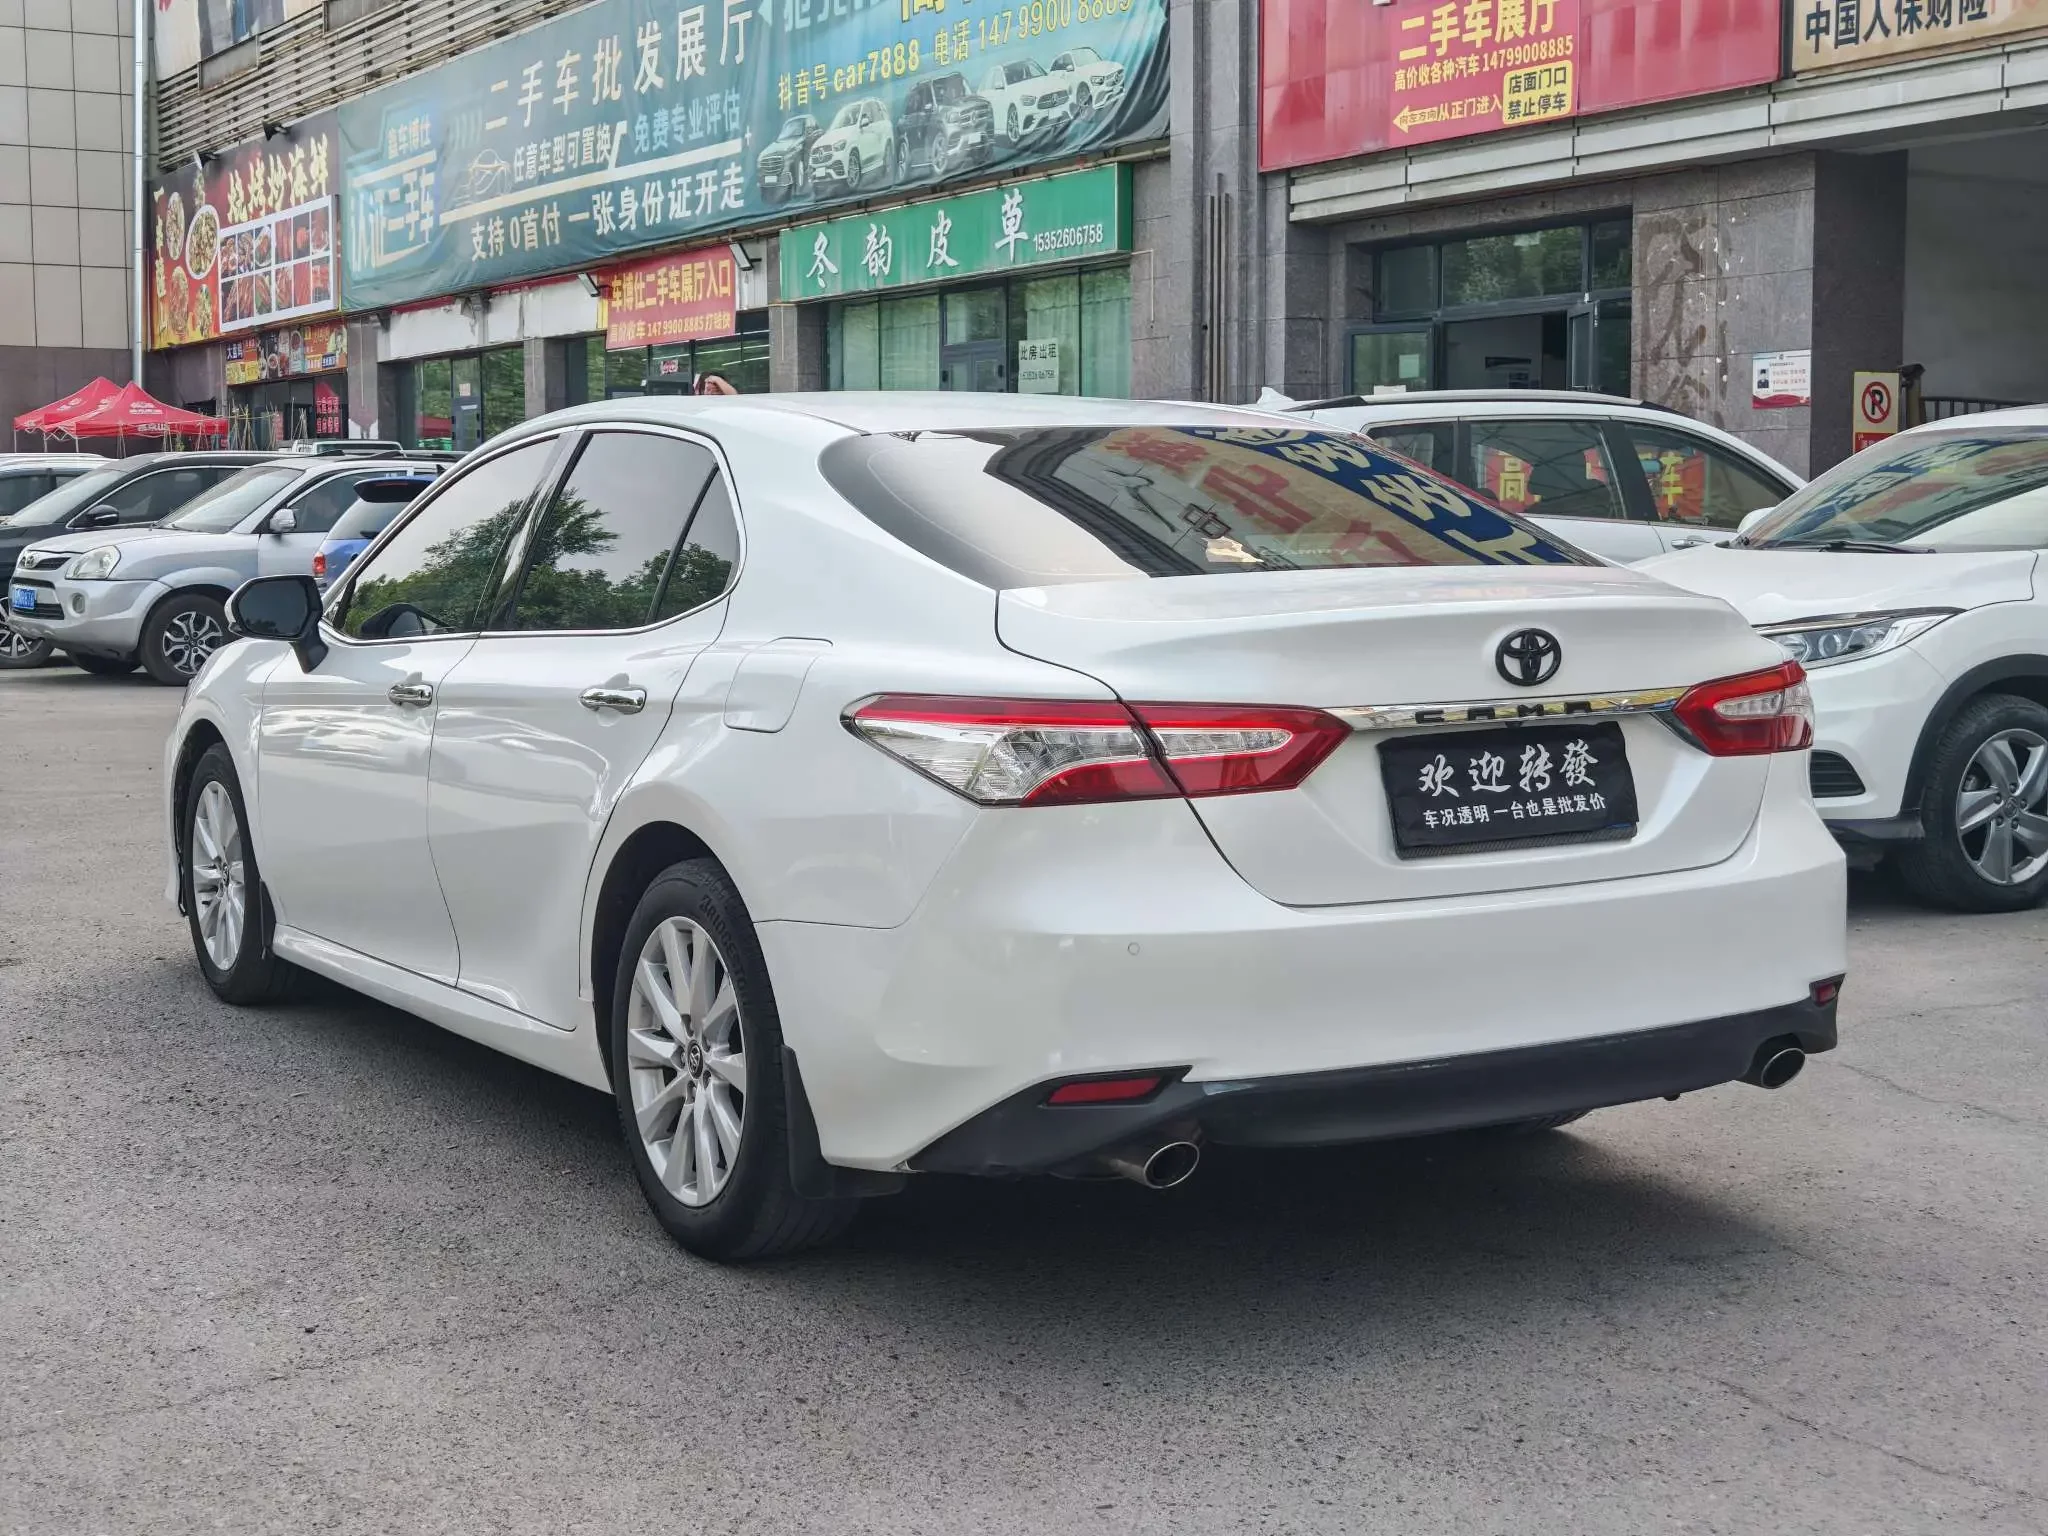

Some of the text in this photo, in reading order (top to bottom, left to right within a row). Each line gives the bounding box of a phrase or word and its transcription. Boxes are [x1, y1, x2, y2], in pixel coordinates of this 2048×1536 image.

[1399, 0, 1560, 60] 二手车展厅
[485, 0, 753, 130] 二手车批发展厅
[778, 63, 827, 110] 抖音号
[834, 39, 919, 92] car7888
[934, 18, 971, 65] 电话
[979, 10, 1012, 51] 147
[1395, 35, 1574, 92] 高价收各种汽车 14799008885
[1508, 66, 1567, 95] 店面门口
[1437, 94, 1502, 121] 从正门进入
[1507, 91, 1567, 121] 禁止停车
[513, 87, 741, 184] 任意车型可置换 免费专业评估
[470, 162, 745, 262] 支持0首付 一张身份证开走
[1033, 223, 1104, 253] 15352606758
[611, 259, 731, 313] 车博仕二手车展厅入口
[648, 320, 662, 337] 147
[1020, 342, 1057, 361] 此房出租
[1423, 792, 1607, 829] 车况透明 一台也是批发价
